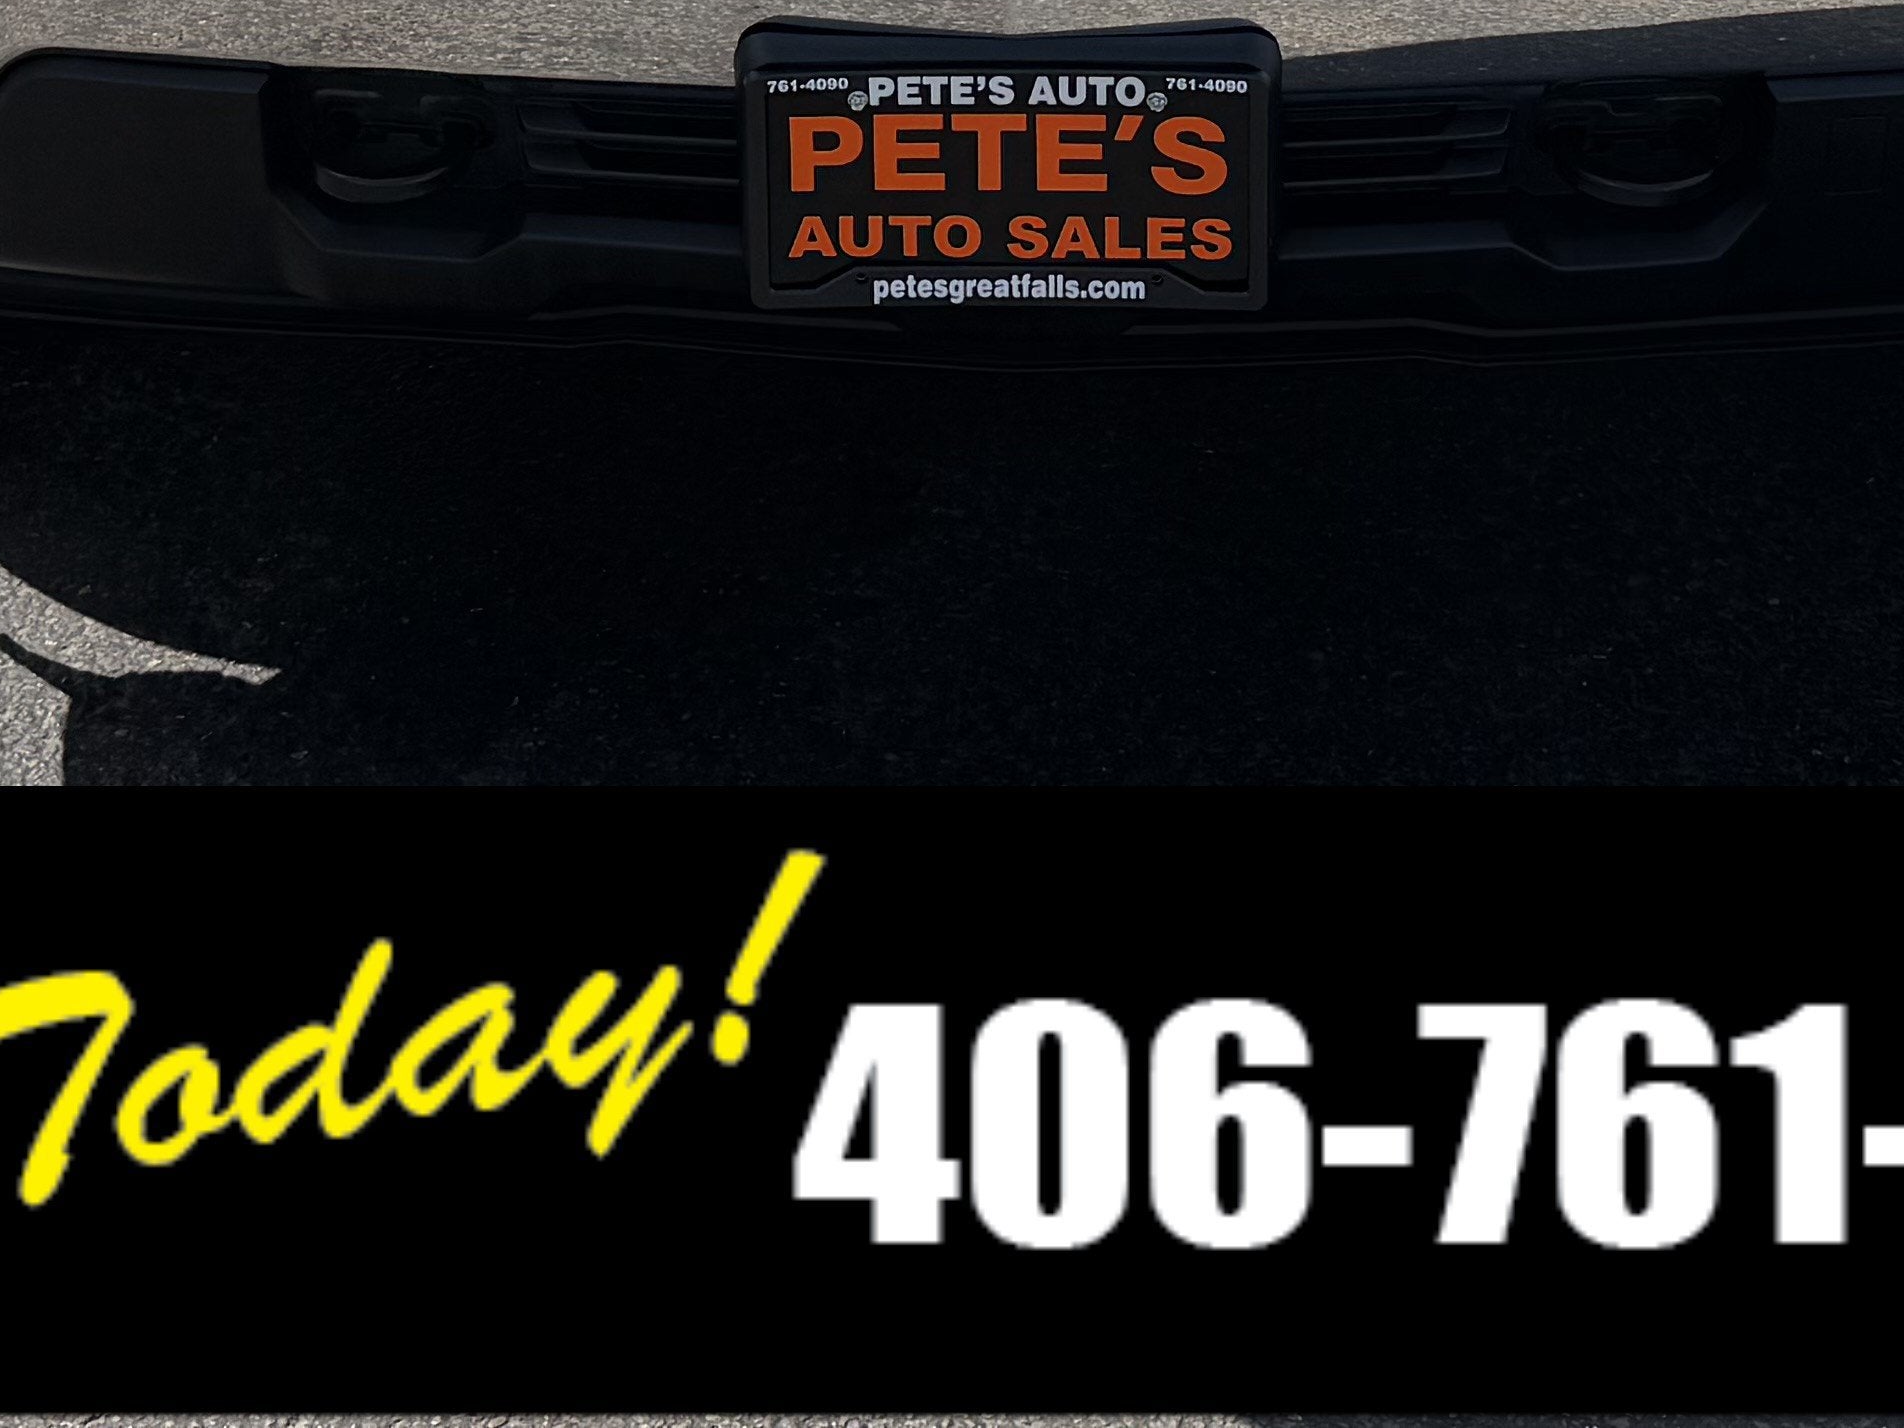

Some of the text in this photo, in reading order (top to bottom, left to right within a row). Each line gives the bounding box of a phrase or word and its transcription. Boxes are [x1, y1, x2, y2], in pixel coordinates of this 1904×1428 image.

[767, 77, 849, 94] 761-4090
[868, 75, 1146, 107] PETE'S AUTO
[1165, 77, 1248, 94] 761-4090
[789, 113, 1228, 195] PETE'S
[789, 215, 1232, 260] AUTO SALES
[872, 273, 1146, 305] petesgreatfalls.com
